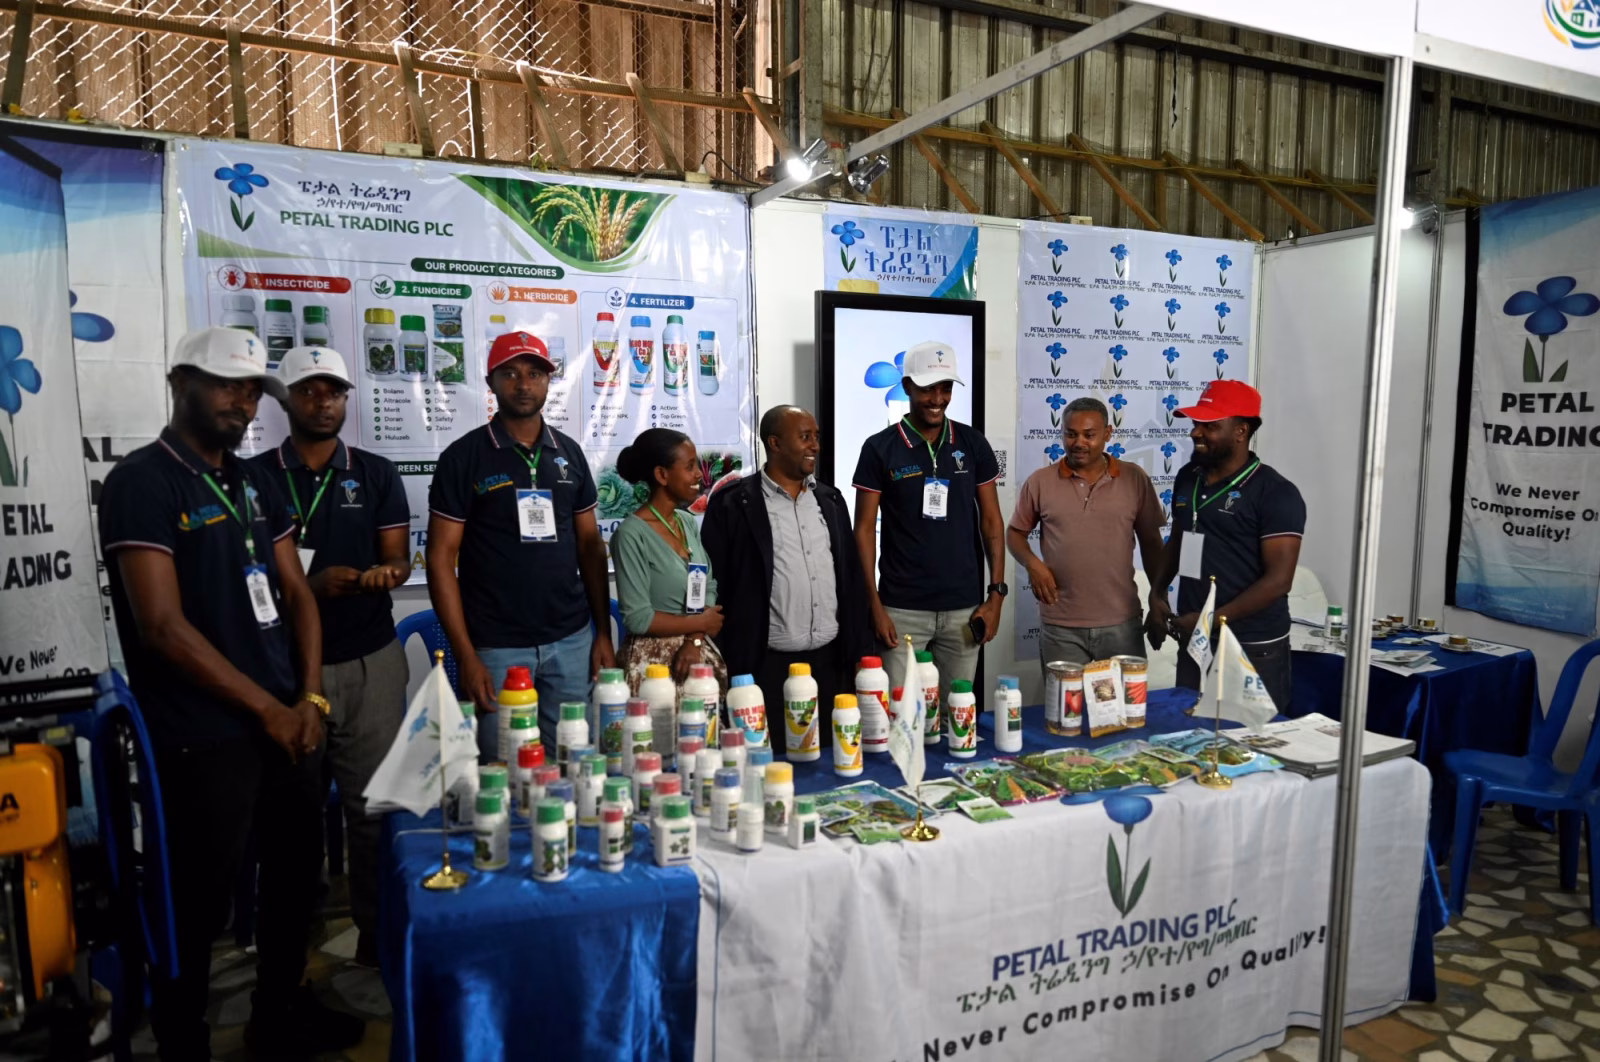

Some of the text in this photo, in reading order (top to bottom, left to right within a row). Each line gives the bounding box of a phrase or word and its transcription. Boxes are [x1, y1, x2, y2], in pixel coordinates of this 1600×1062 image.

[280, 211, 454, 237] PETAL TRADING PLC
[425, 261, 557, 277] OUR PRODUCT CATEGORIES
[1047, 275, 1071, 283] TRADING
[252, 278, 330, 290] 1. INSECTICIDE
[401, 286, 462, 296] 2. FUNGICIDE
[513, 291, 569, 302] 3. HERBICIDE
[630, 297, 685, 307] 4. FERTILIZER
[1500, 392, 1595, 413] PETAL
[1496, 482, 1580, 501] We Never
[1471, 497, 1576, 521] Compromise
[2, 503, 54, 536] ETAL
[1502, 521, 1570, 543] Quality!
[993, 898, 1238, 981] PETAL TRADING PLC
[923, 1025, 1007, 1062] Never
[1023, 983, 1196, 1034] Compromise
